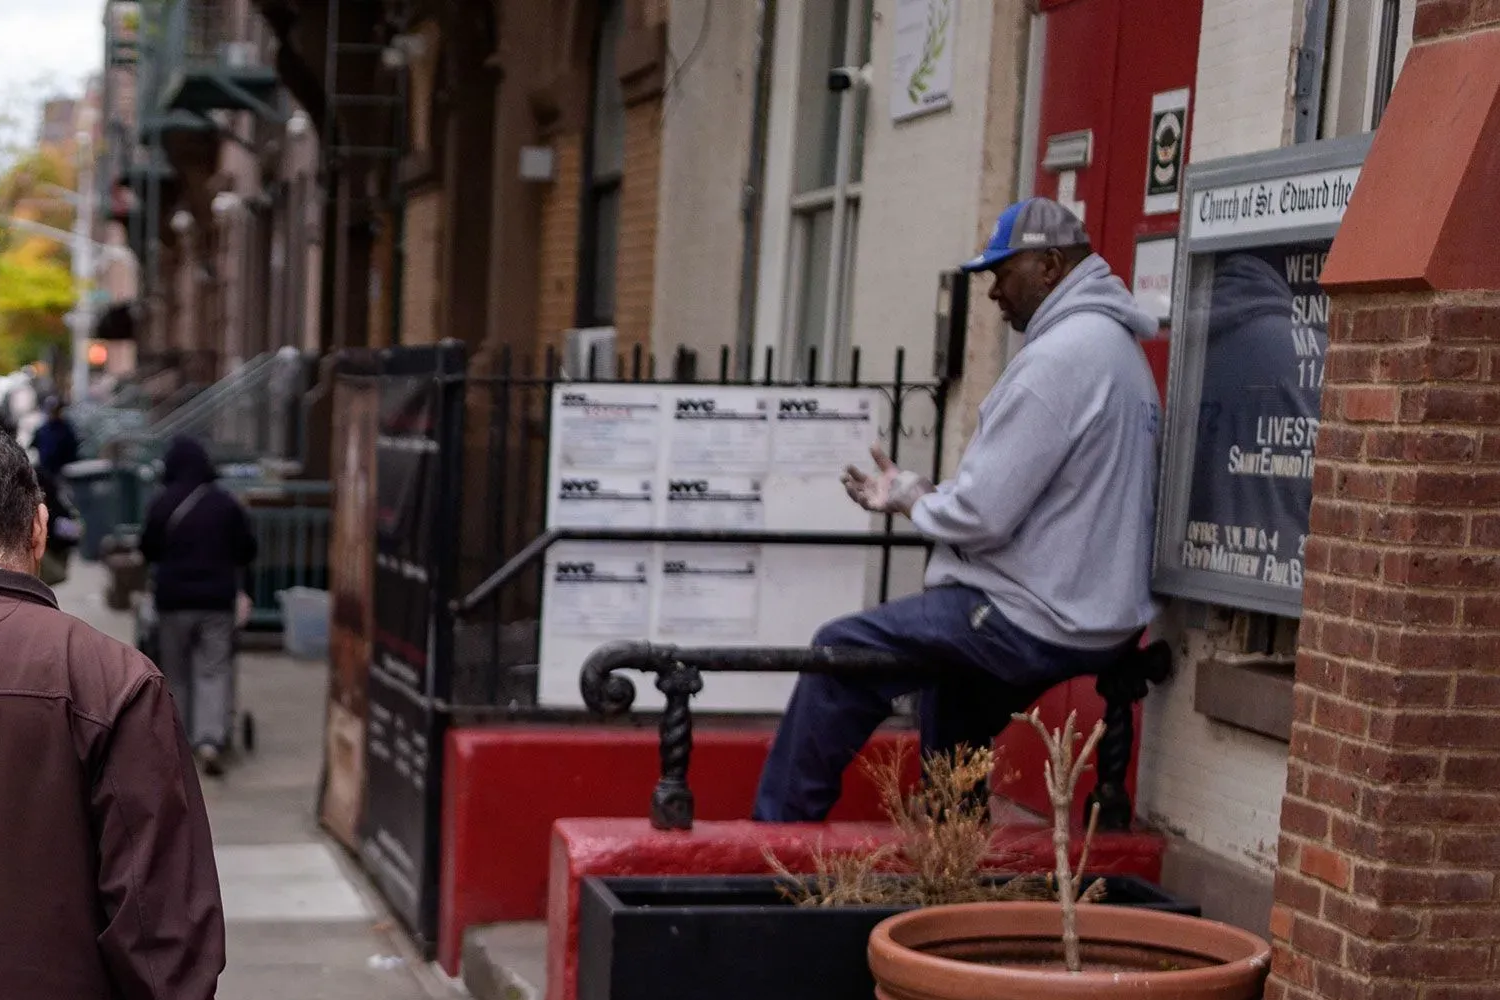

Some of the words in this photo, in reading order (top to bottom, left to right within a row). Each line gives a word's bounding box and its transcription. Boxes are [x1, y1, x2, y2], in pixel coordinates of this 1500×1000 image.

[1200, 190, 1239, 227] Church
[1241, 187, 1253, 218] of
[1255, 184, 1275, 217] St.
[1279, 178, 1329, 214] Edward
[676, 399, 715, 412] NYC
[780, 399, 818, 412] NYC
[561, 479, 599, 492] NYC
[668, 480, 708, 493] NYC
